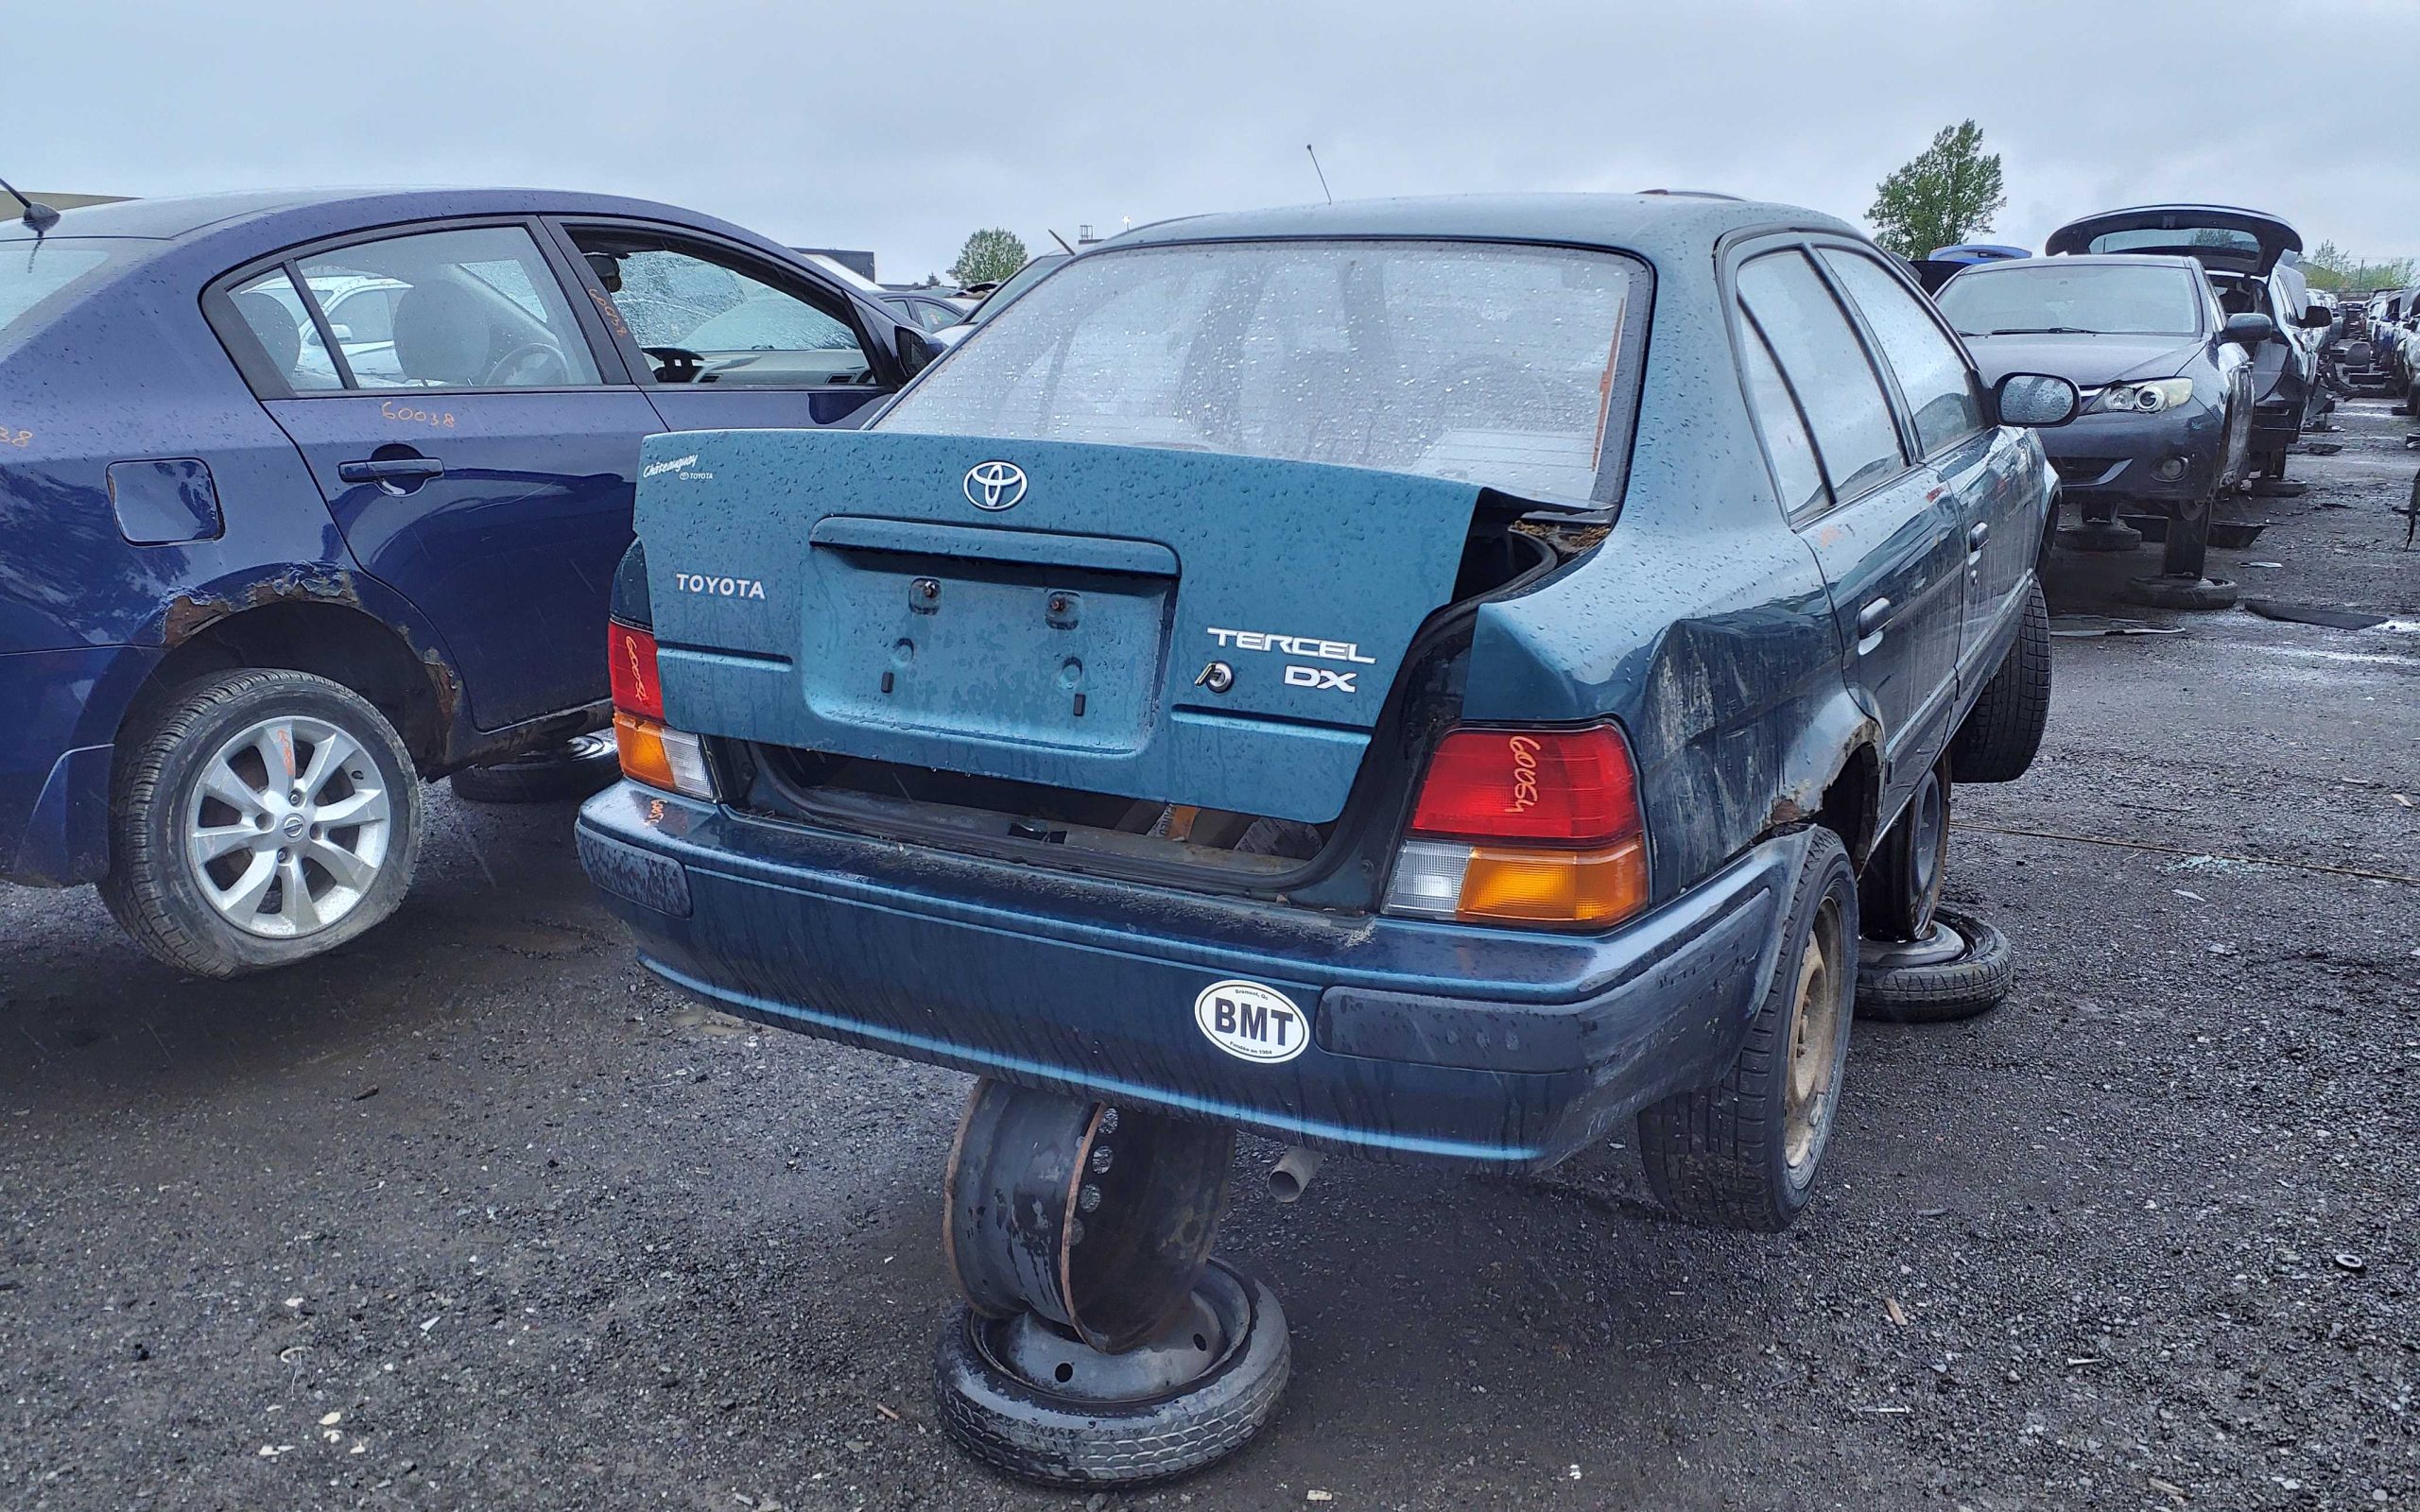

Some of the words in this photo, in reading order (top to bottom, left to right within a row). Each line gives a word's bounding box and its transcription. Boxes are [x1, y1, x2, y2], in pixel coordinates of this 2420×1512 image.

[381, 401, 455, 428] 60038
[676, 573, 766, 599] TOYOTA
[1207, 627, 1376, 664] TERCEL
[1284, 664, 1357, 693] DX
[1504, 735, 1542, 813] 60054
[1215, 997, 1294, 1047] BMT
